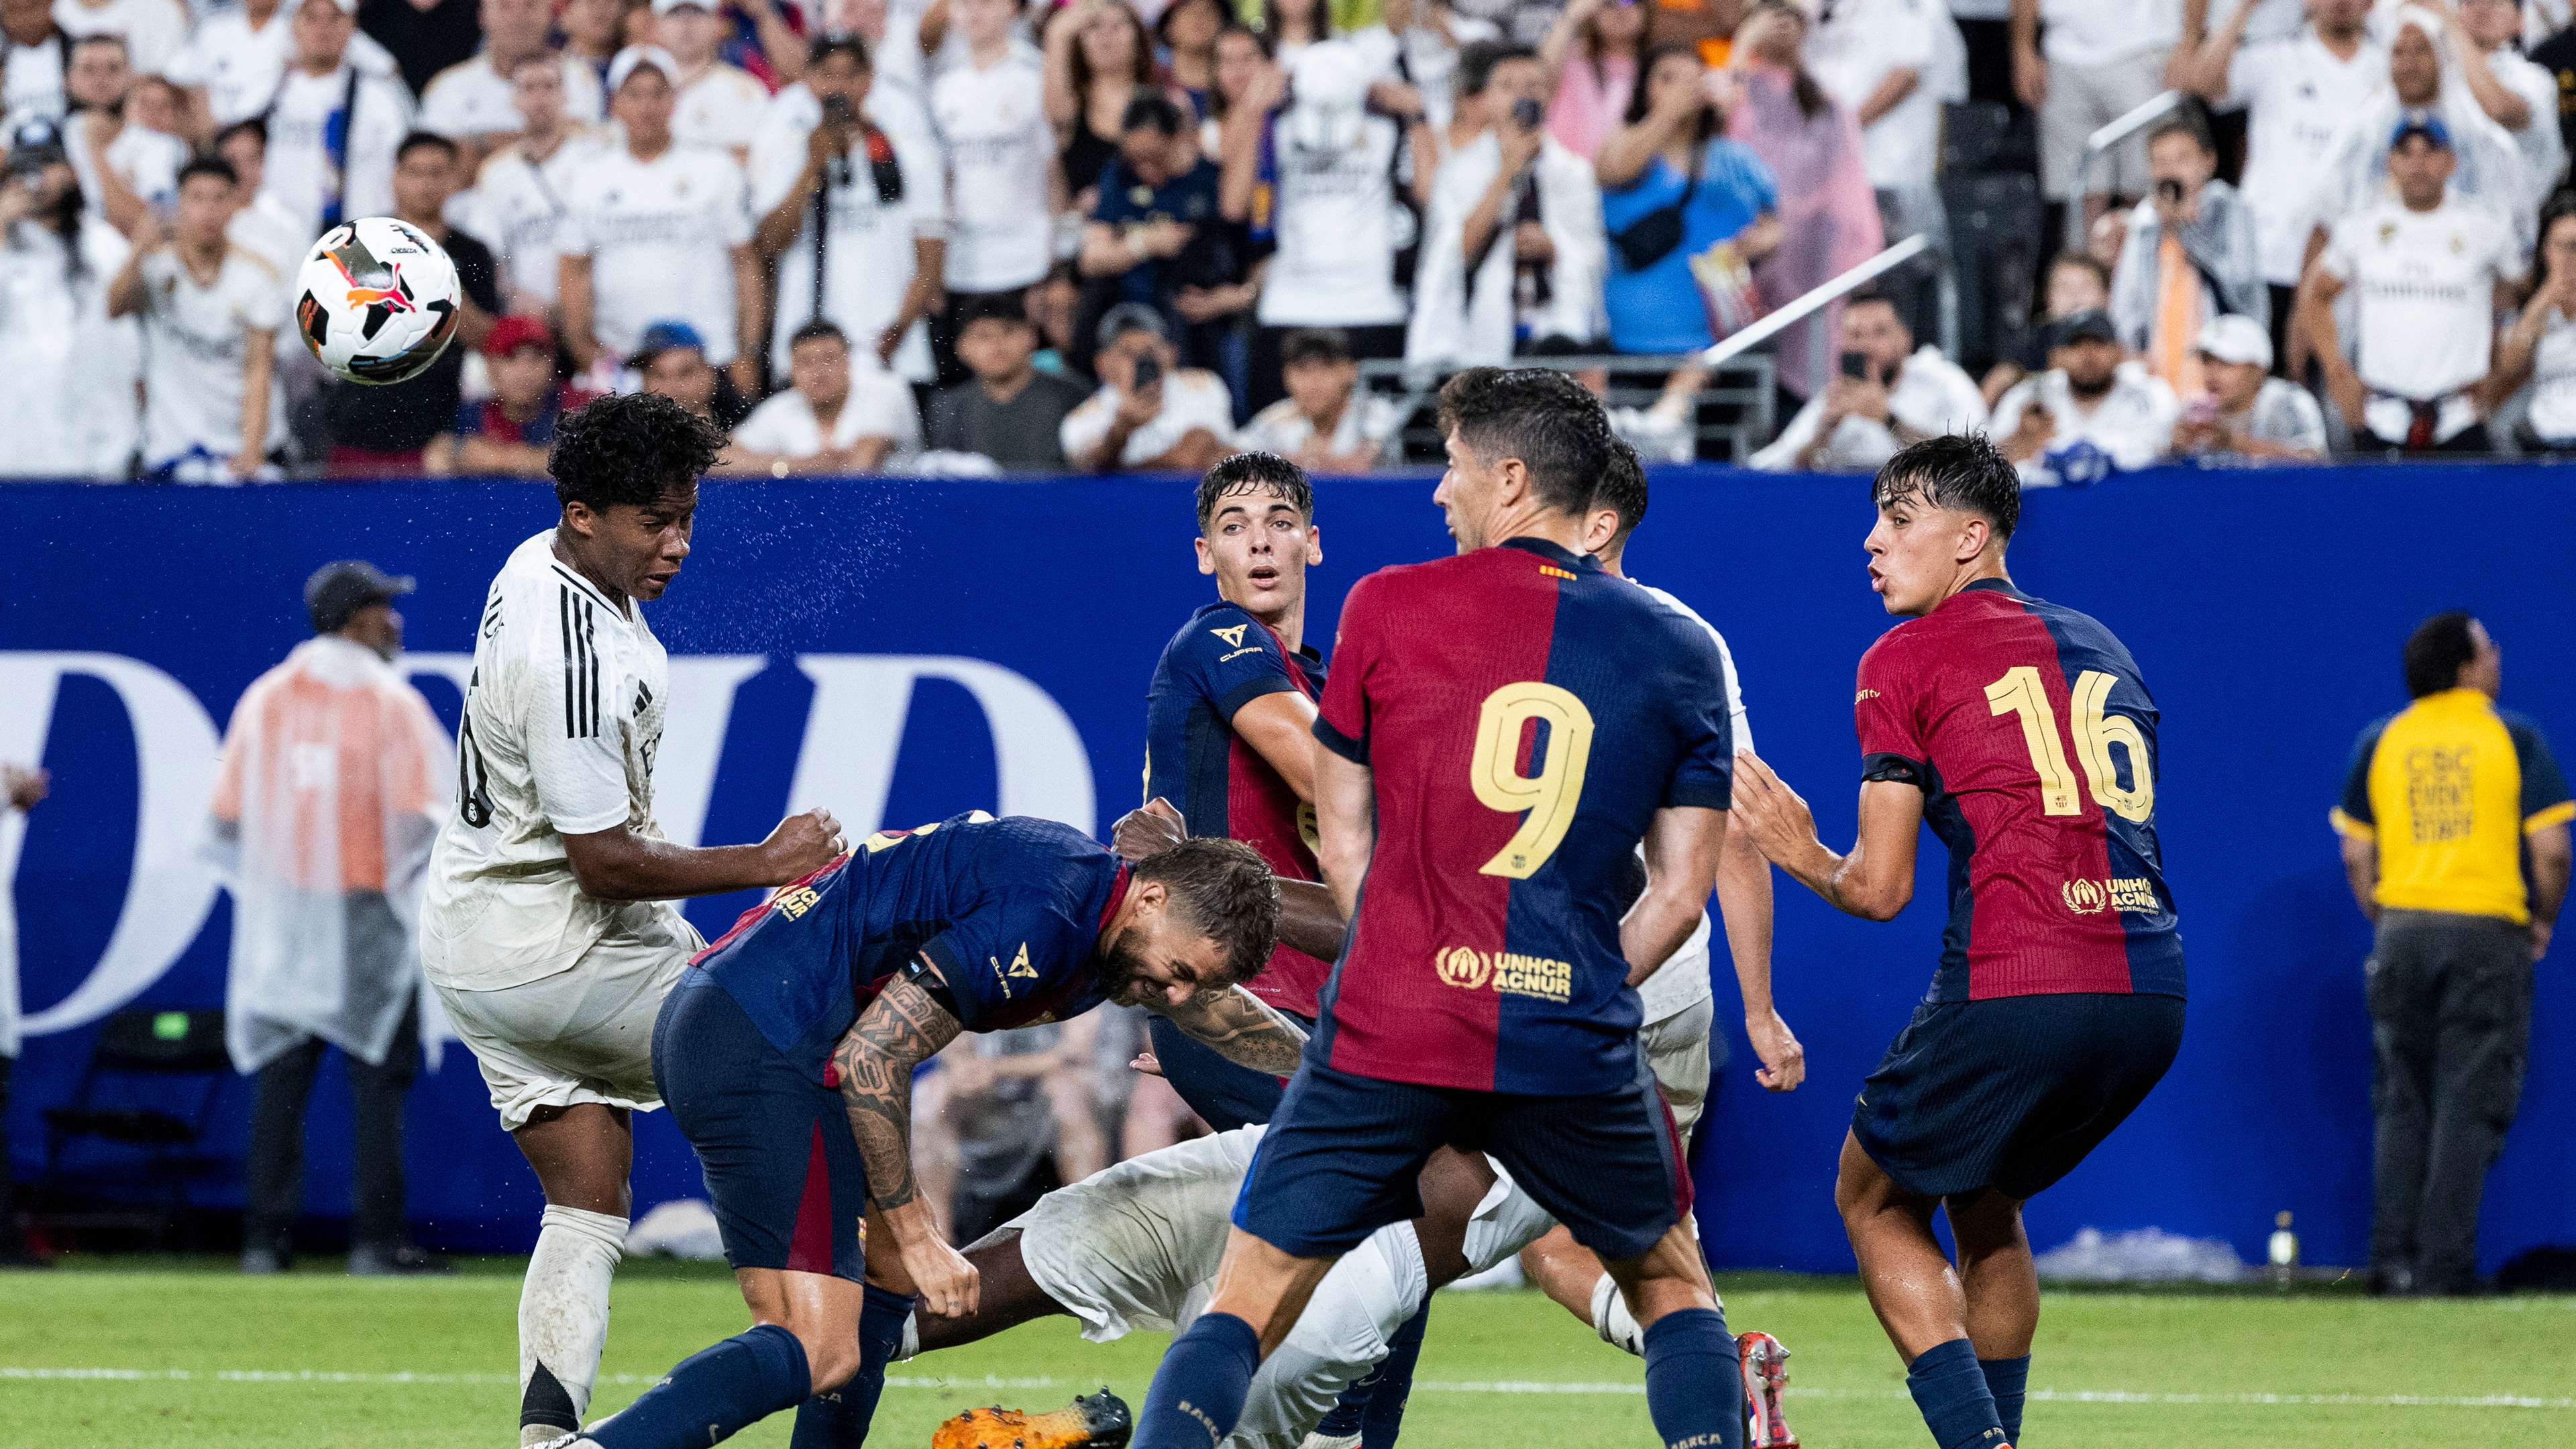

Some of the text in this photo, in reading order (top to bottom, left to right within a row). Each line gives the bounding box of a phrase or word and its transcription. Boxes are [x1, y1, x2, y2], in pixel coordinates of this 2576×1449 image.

[1220, 647, 1263, 662] CUPRA
[1983, 666, 2154, 822] 16
[1470, 681, 1595, 880] 9
[1495, 952, 1572, 981] UNHCR
[1491, 970, 1570, 996] ACNUR
